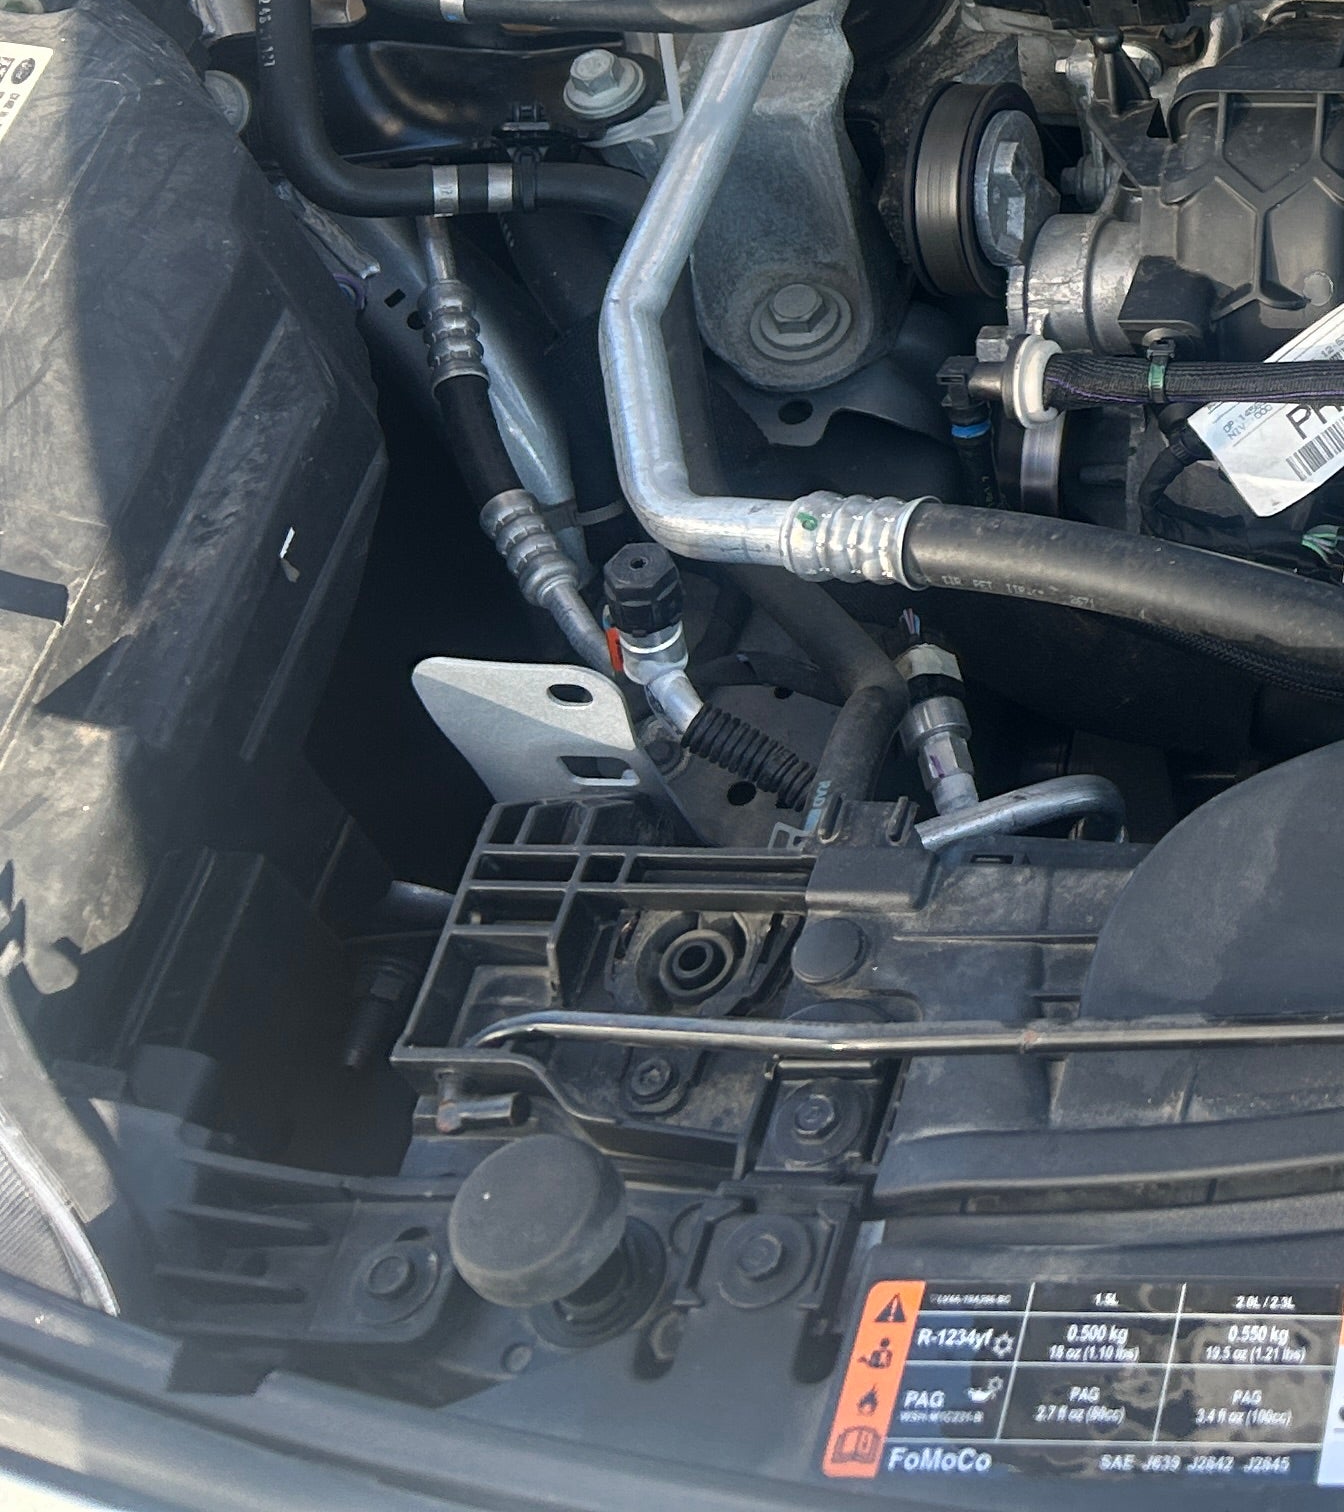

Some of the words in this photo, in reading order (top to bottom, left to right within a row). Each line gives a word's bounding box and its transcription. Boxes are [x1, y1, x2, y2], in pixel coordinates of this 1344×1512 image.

[917, 1327, 994, 1350] R-1234yf
[1067, 1324, 1105, 1342] 0.500
[1108, 1325, 1129, 1346] kg
[1228, 1325, 1268, 1342] 0.550
[1270, 1326, 1290, 1346] kg
[1067, 1348, 1081, 1360] oz
[1233, 1349, 1248, 1360] oz
[903, 1390, 945, 1408] PAG
[1069, 1386, 1100, 1402] PAG
[1231, 1389, 1262, 1405] PAG
[1035, 1405, 1056, 1422] 2.7
[1068, 1408, 1084, 1422] oz
[1196, 1408, 1217, 1424] 3.4
[1228, 1411, 1245, 1424] oz
[888, 1447, 993, 1472] FoMoCo
[1100, 1454, 1135, 1471] SAE
[1141, 1455, 1181, 1472] J639
